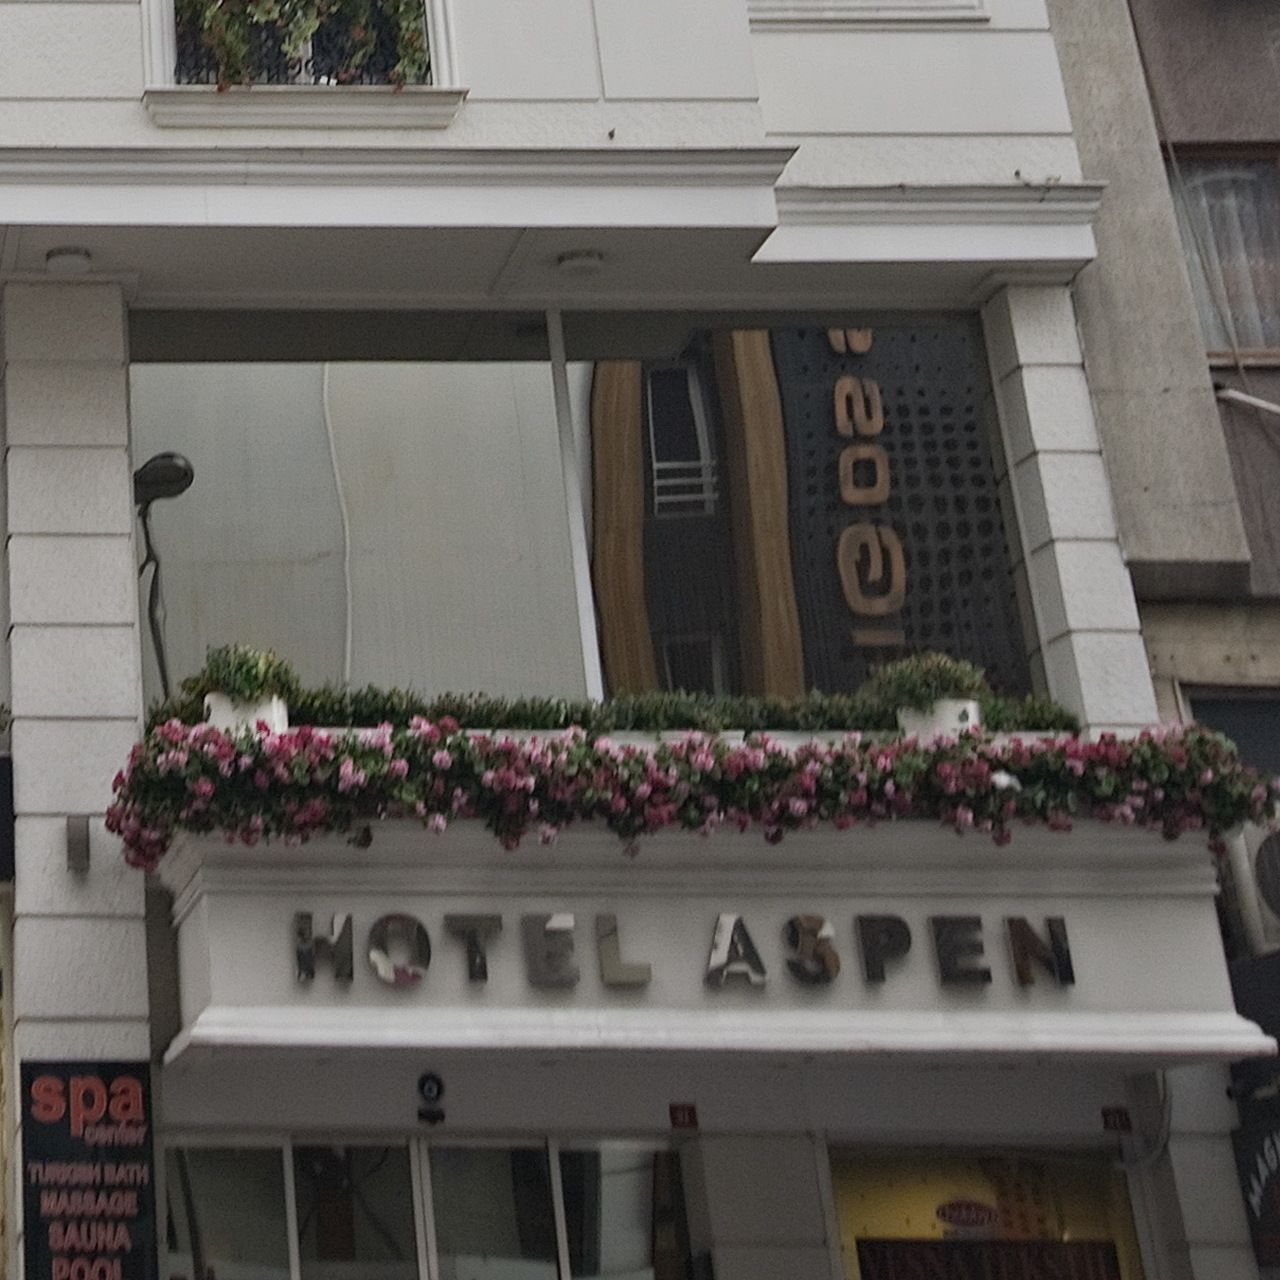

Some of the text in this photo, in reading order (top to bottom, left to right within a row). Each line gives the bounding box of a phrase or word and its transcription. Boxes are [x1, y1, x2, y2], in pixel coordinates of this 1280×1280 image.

[292, 910, 1076, 989] HOTEL ASPEN
[31, 1075, 145, 1138] spa
[104, 1162, 150, 1186] BATH
[40, 1190, 138, 1217] MASSAGE
[48, 1220, 132, 1254] SAUNA
